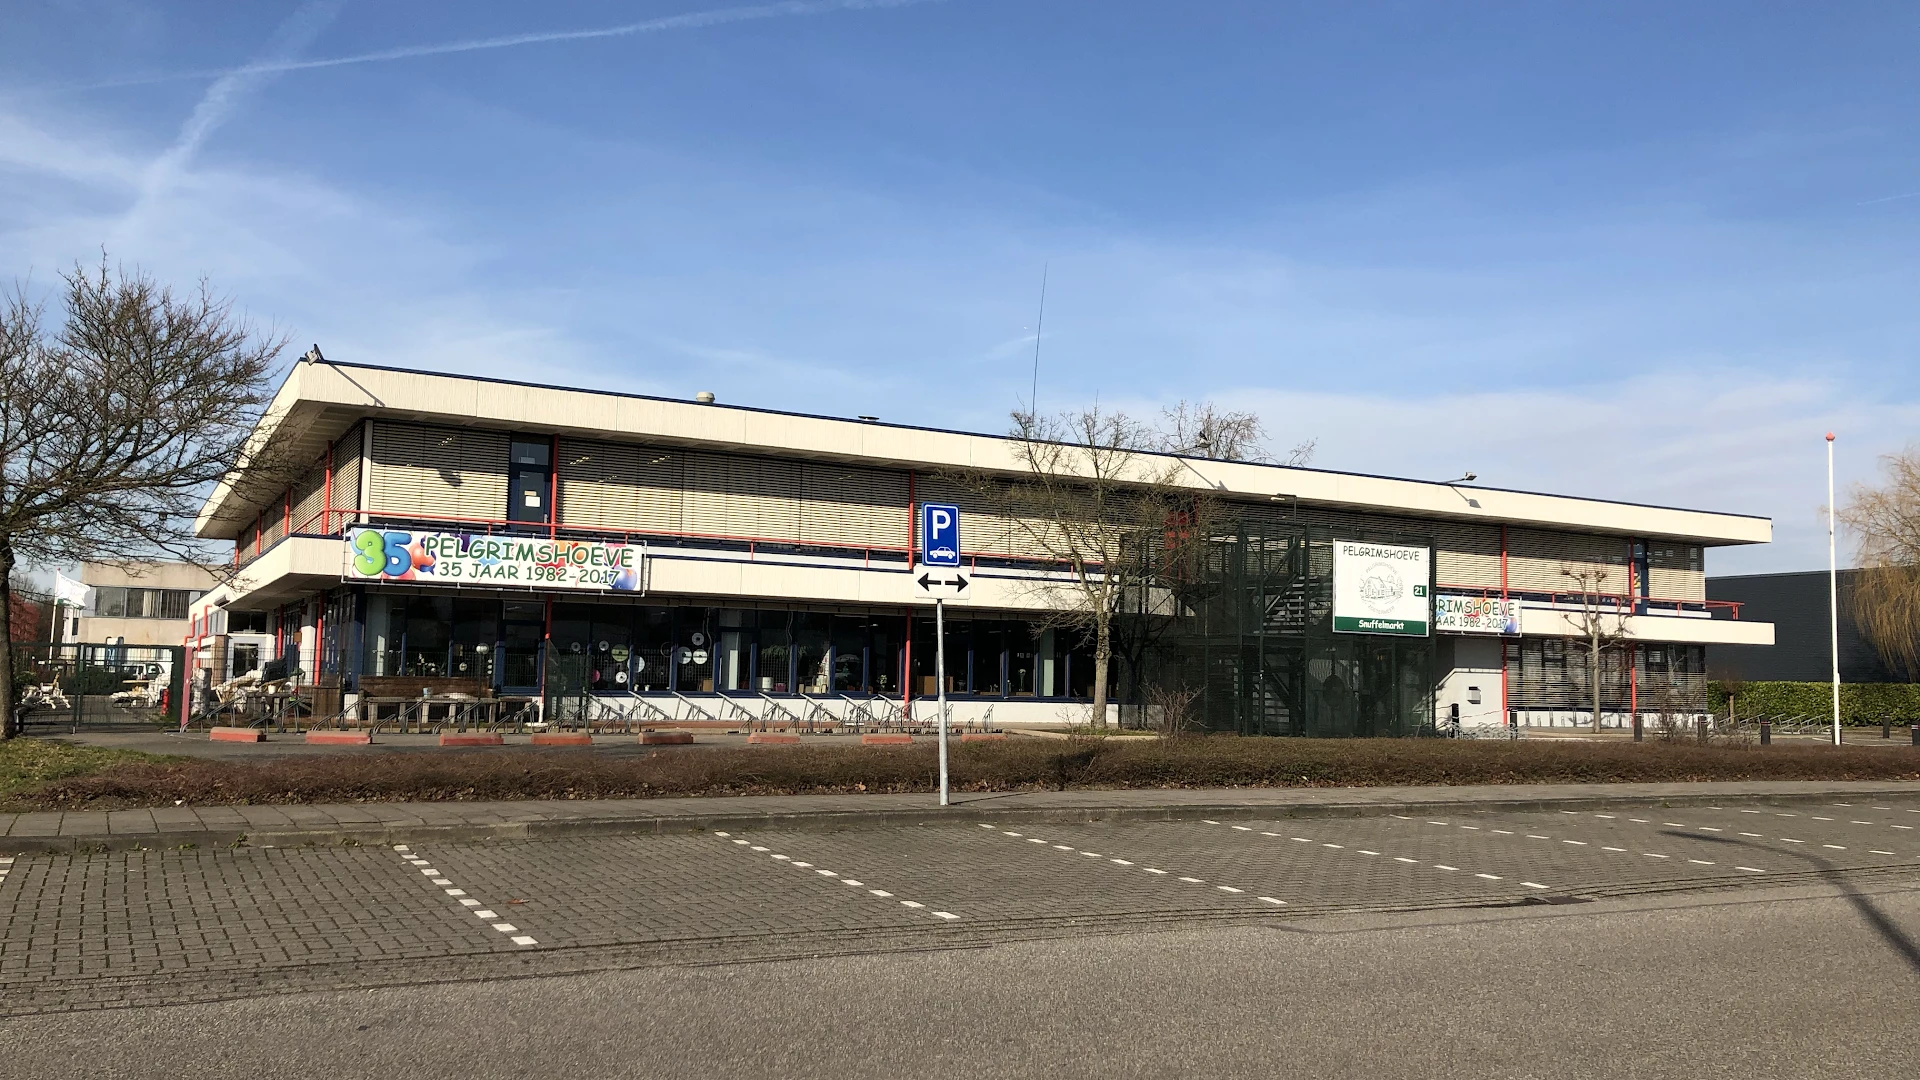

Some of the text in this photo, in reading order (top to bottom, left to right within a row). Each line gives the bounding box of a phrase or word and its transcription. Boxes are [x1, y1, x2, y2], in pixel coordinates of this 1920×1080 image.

[932, 510, 951, 540] P
[354, 530, 412, 576] 35
[425, 537, 634, 568] PELGRIMSHOEVE
[1343, 545, 1420, 561] PELGRIMSHOEVE
[440, 562, 620, 585] 35 JAAR 1982-2017
[1414, 586, 1424, 596] 21
[1436, 599, 1515, 617] RIMSHOEVE
[1358, 619, 1405, 630] Snuffelmarkt
[1459, 616, 1508, 629] 1982-2017
